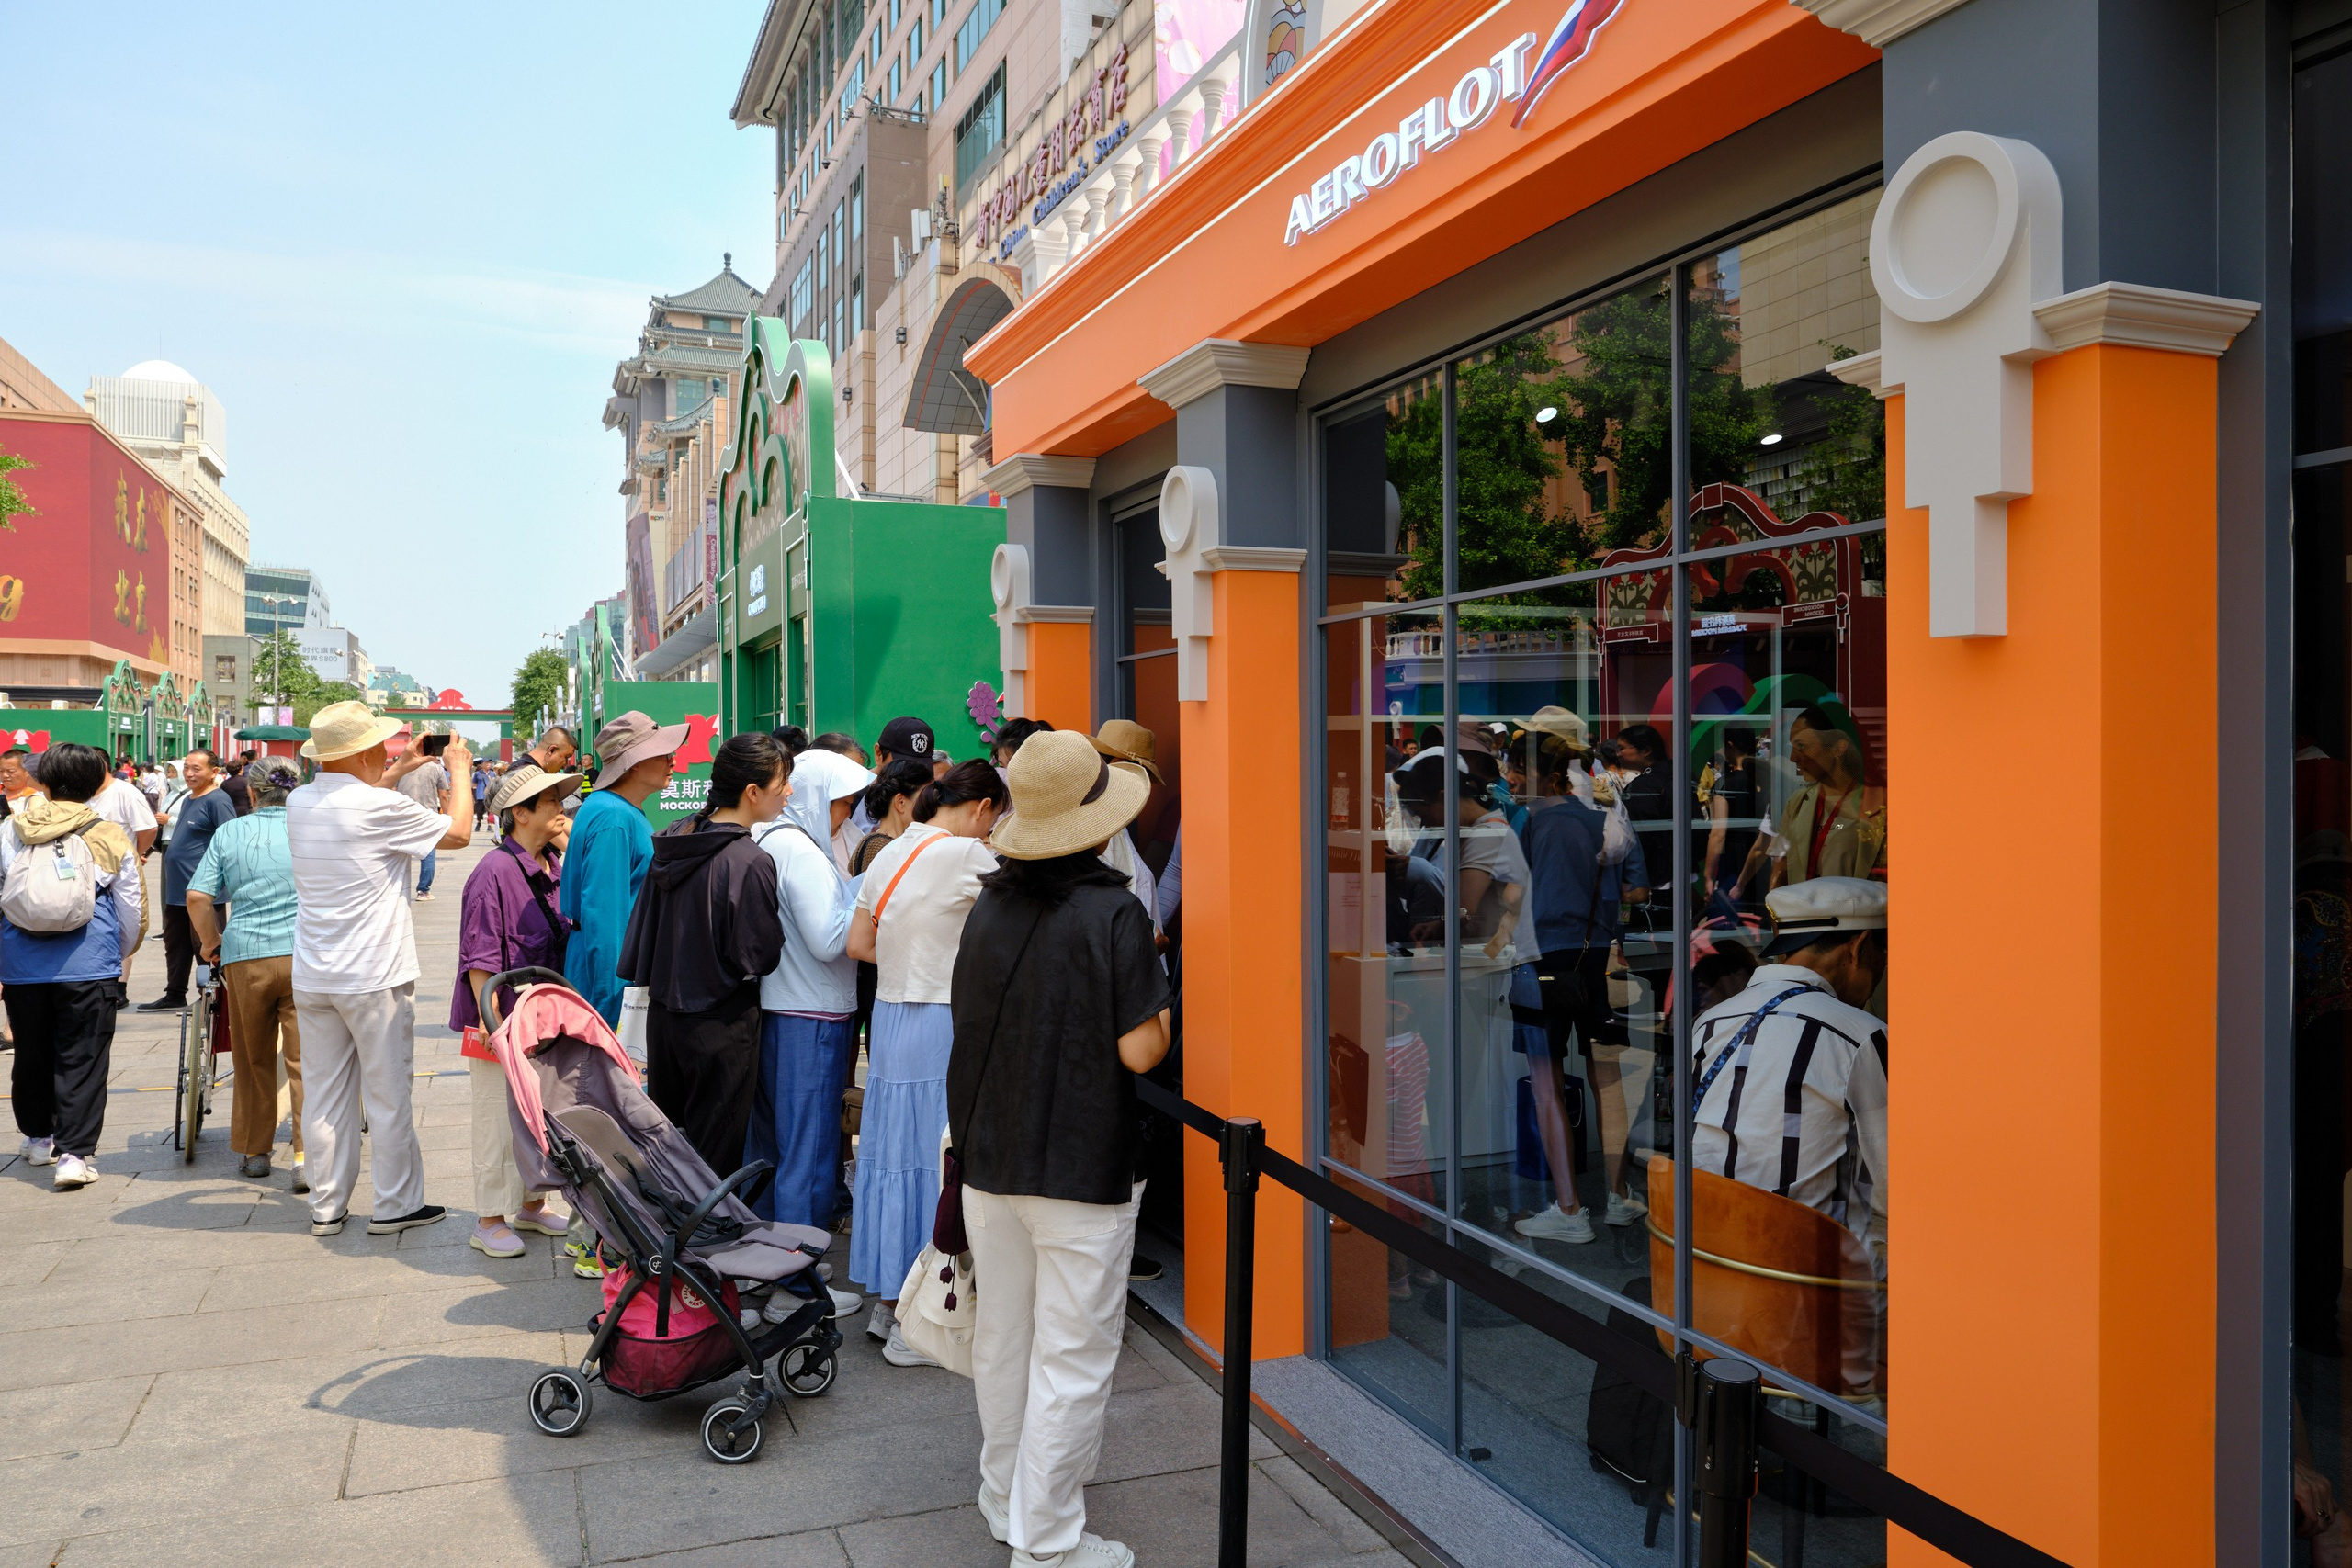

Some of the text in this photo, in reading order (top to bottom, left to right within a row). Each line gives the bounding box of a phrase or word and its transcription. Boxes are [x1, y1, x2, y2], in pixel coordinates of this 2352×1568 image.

[976, 42, 1129, 250] 新中国儿童用品商店
[1032, 156, 1089, 226] Children's
[1094, 119, 1130, 164] Store
[1283, 32, 1537, 246] AEROFLOT
